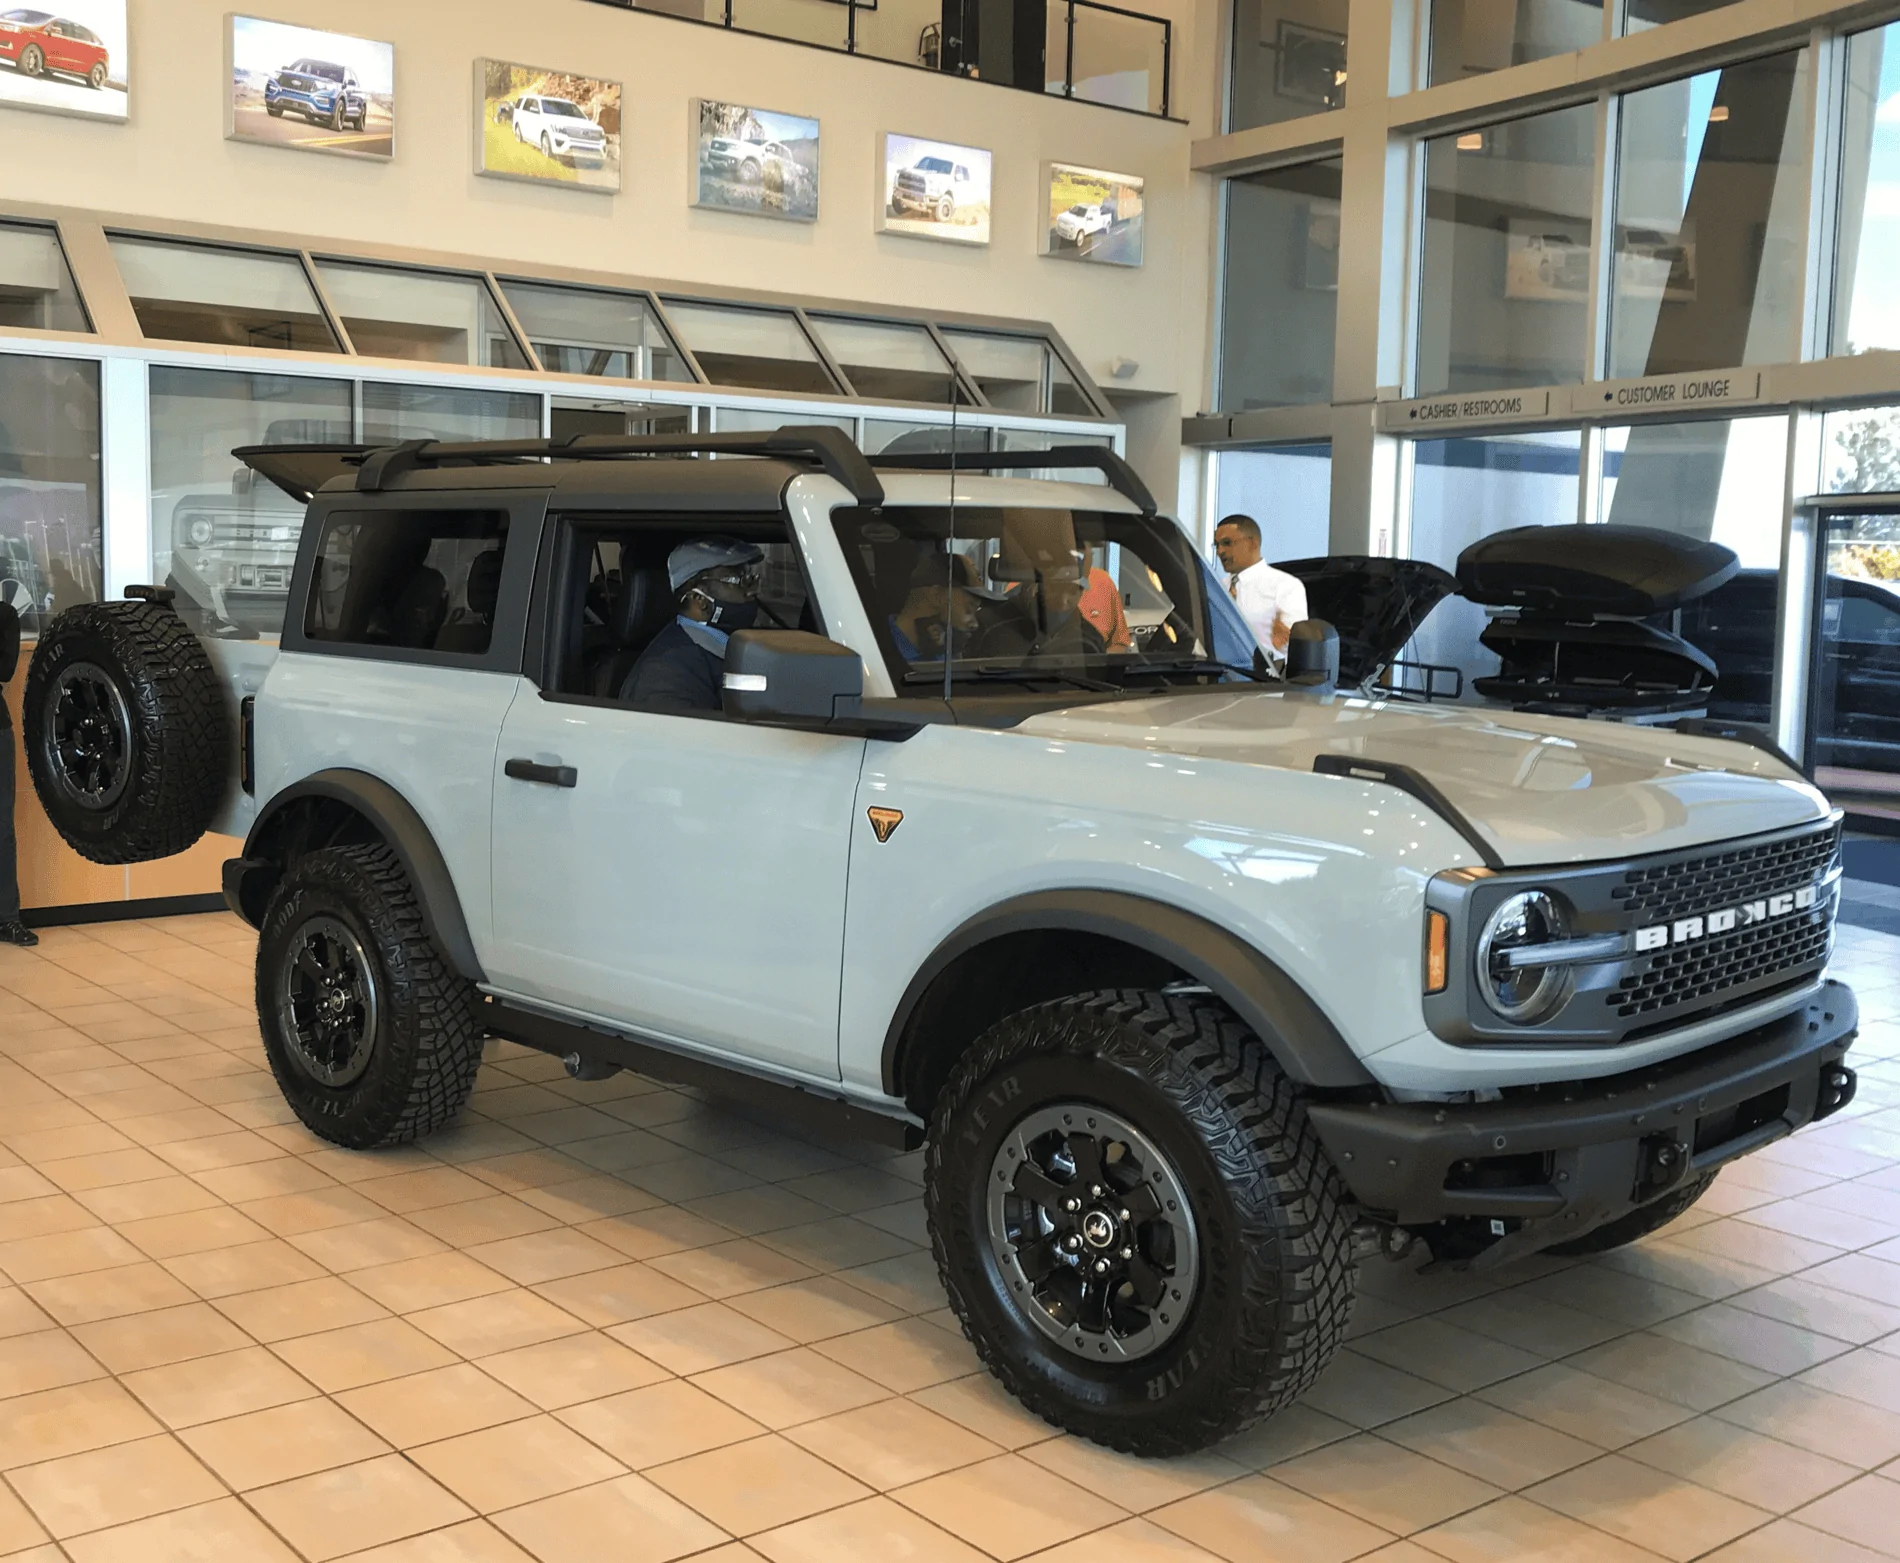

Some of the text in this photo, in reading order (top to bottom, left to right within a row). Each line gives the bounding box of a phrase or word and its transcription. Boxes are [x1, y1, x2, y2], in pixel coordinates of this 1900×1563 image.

[1618, 379, 1730, 405] CUSTOMER LOUNGE
[1635, 885, 1817, 952] BRONCO
